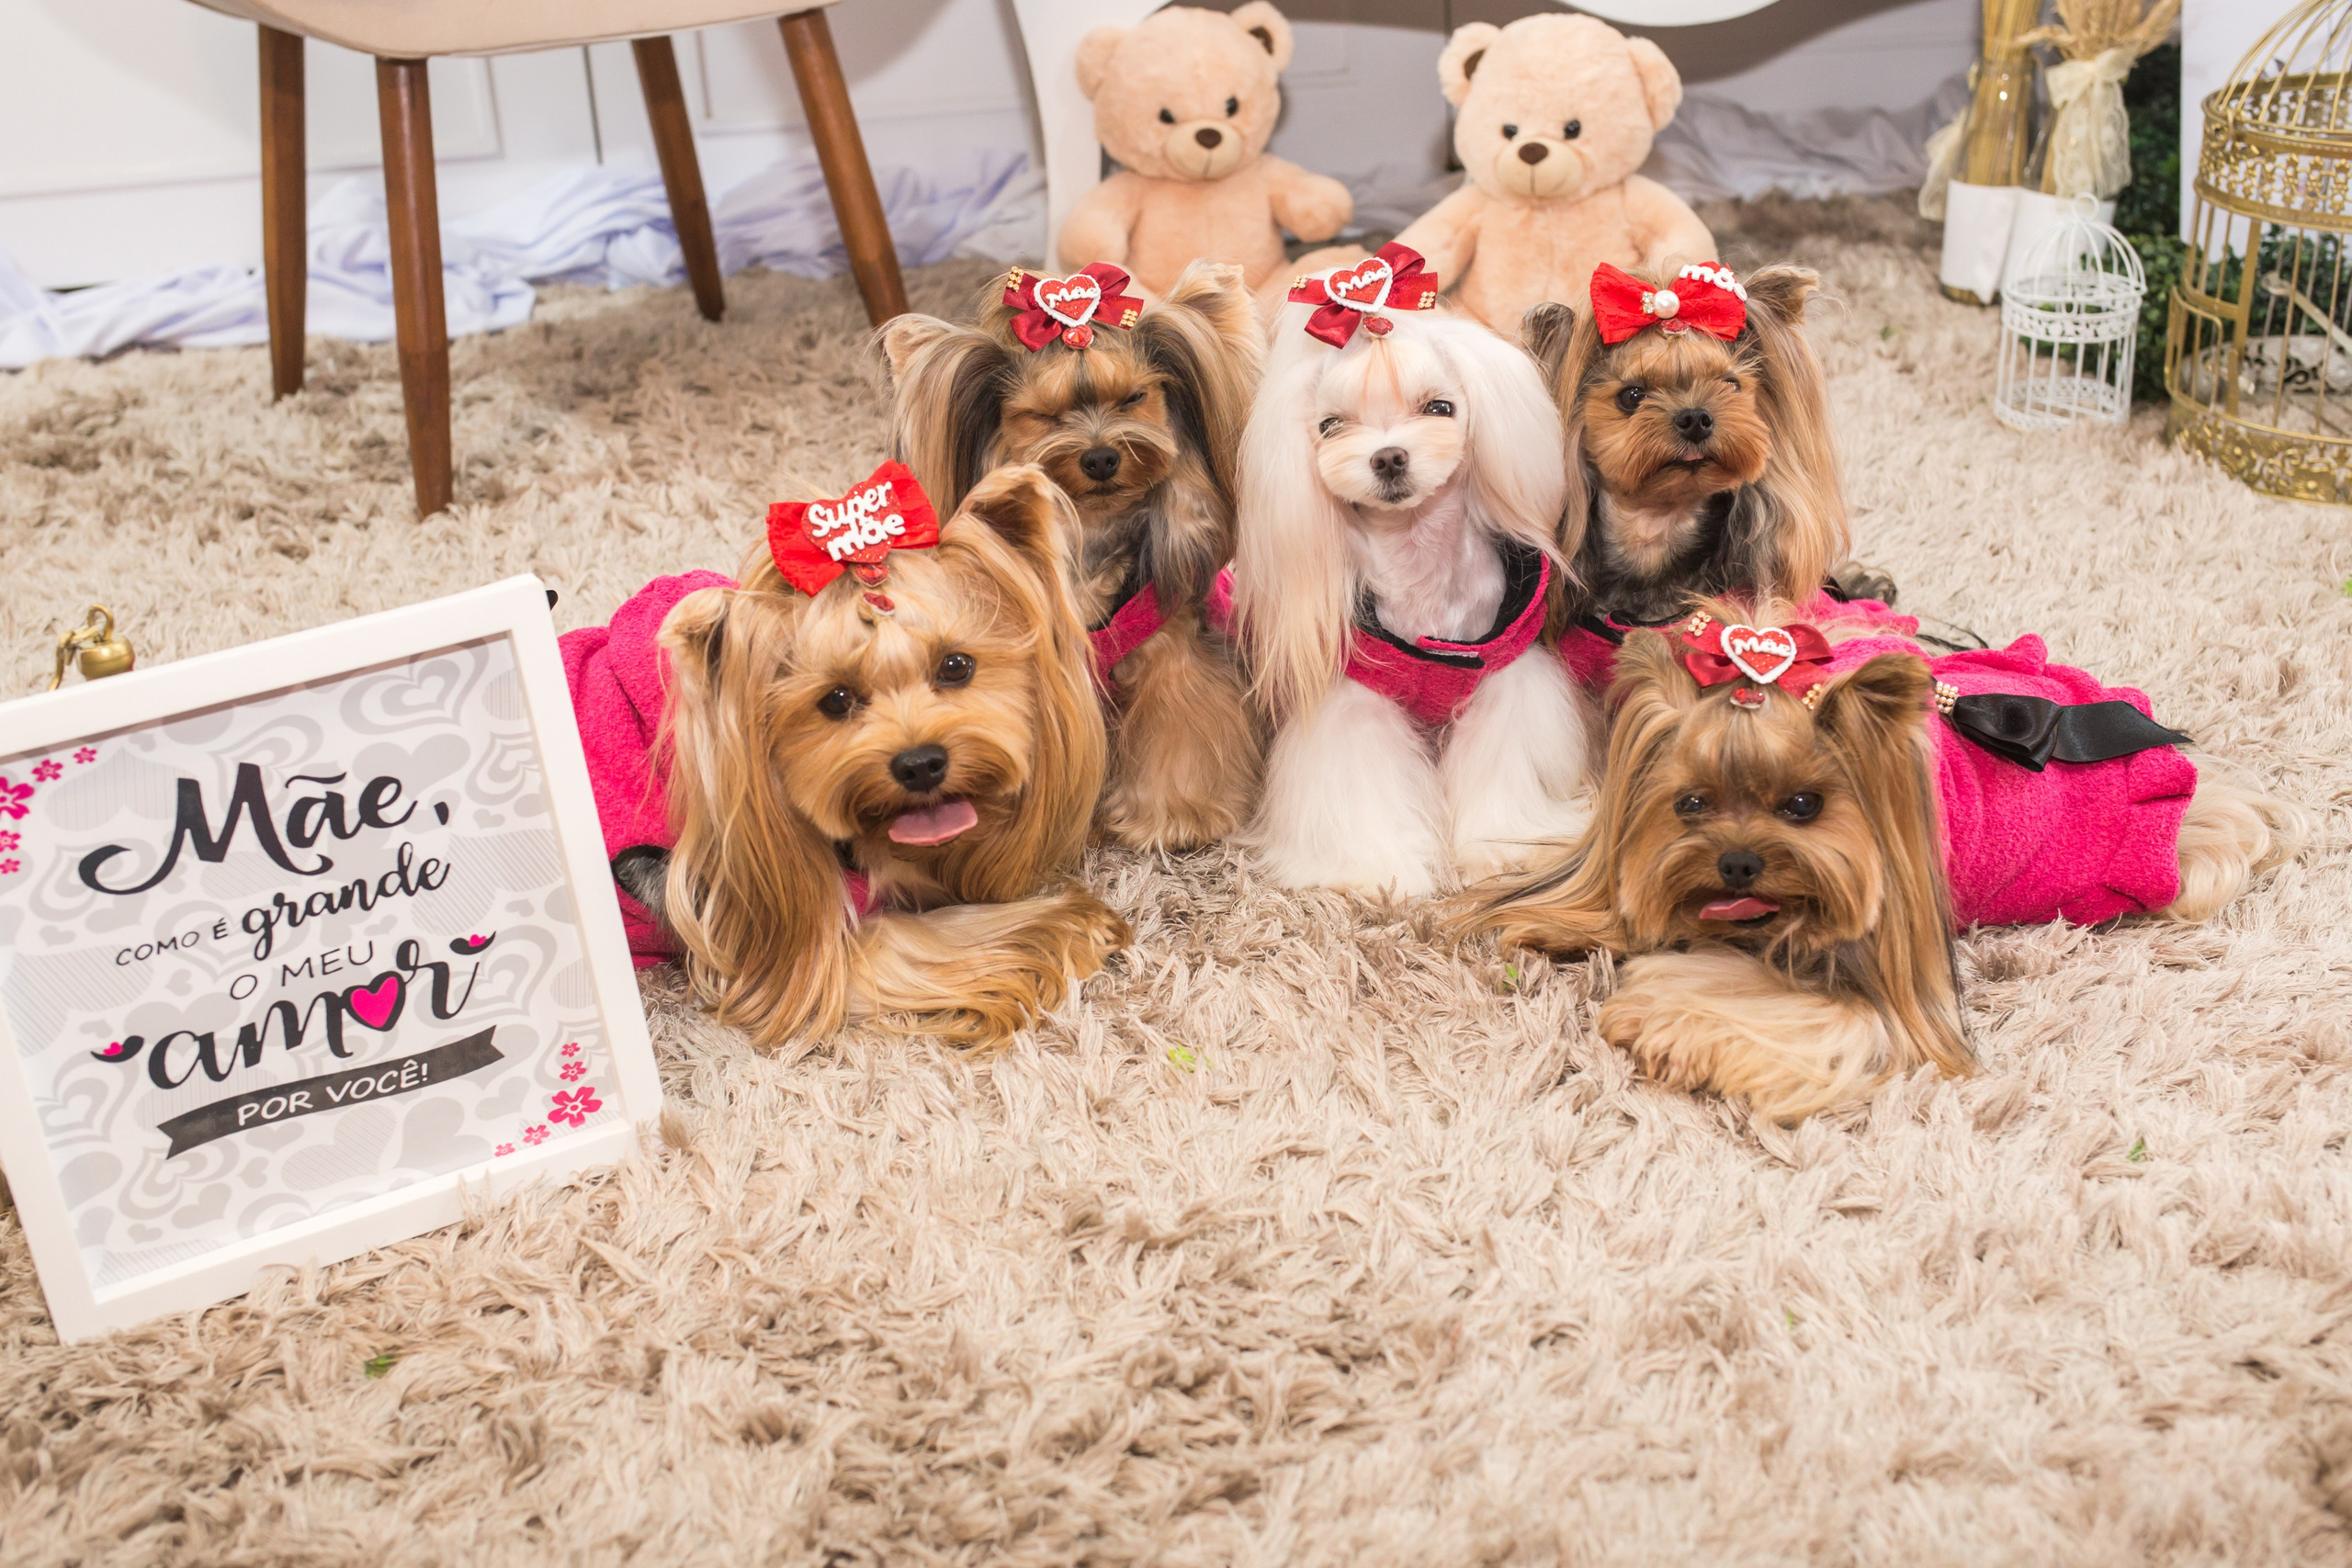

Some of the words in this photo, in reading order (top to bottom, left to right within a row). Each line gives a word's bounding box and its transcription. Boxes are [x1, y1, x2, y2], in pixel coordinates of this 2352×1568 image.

[808, 481, 892, 537] Super
[78, 761, 449, 896] Mãe,
[116, 931, 199, 966] COMO
[212, 919, 229, 940] É
[242, 841, 451, 961] grande
[148, 939, 480, 1090] amor
[229, 974, 258, 1000] O
[281, 941, 374, 987] MEU
[236, 1090, 313, 1126] POR
[327, 1060, 429, 1101] VOCÊ!
